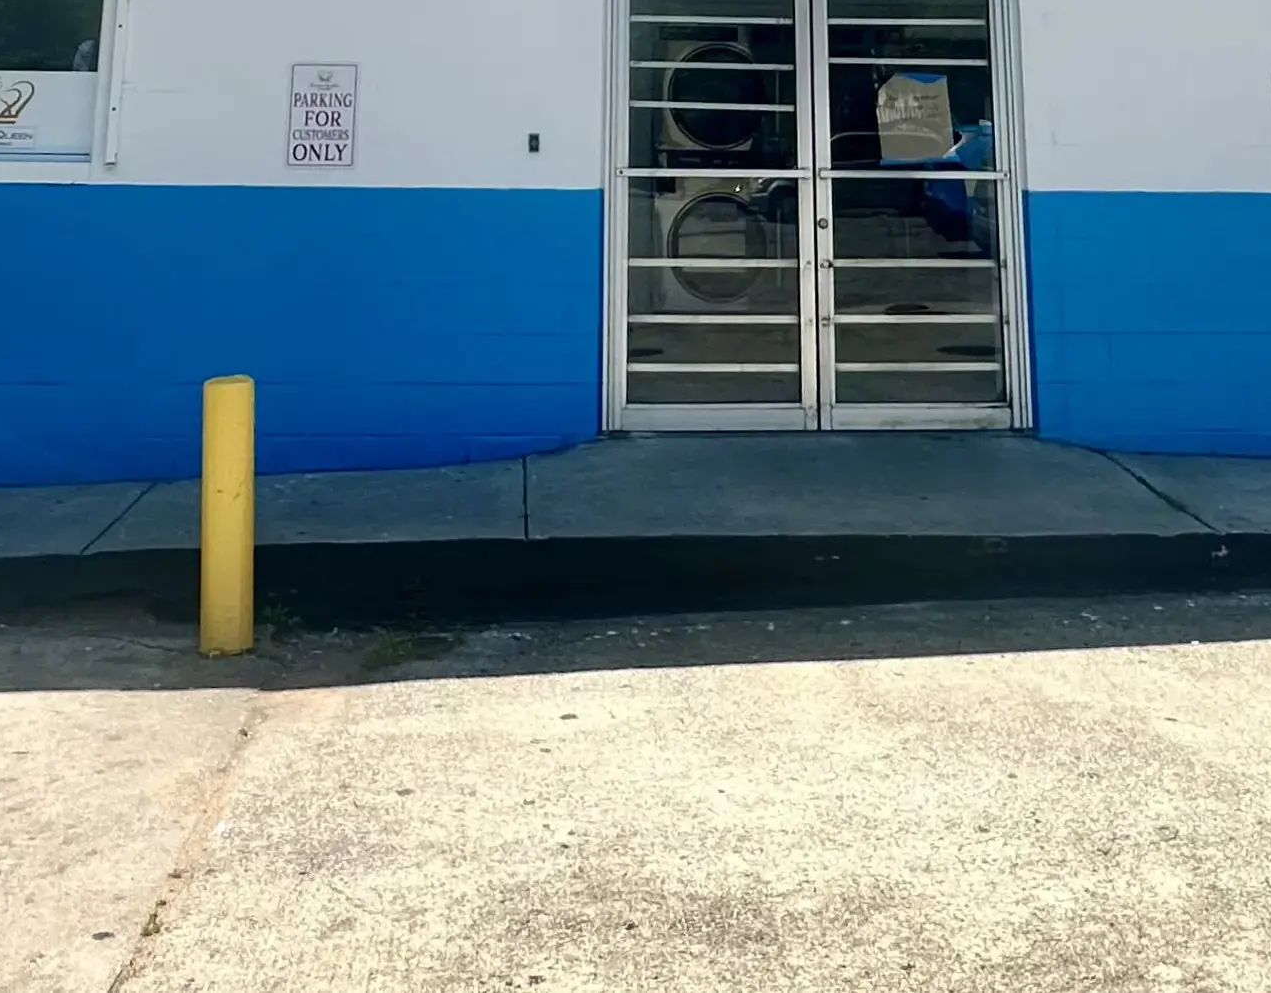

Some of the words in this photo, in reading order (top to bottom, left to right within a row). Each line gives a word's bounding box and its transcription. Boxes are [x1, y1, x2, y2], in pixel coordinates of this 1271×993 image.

[293, 92, 353, 108] PARKING
[303, 110, 342, 127] FOR
[292, 128, 350, 141] CUSTOMERS
[292, 143, 349, 161] ONLY
